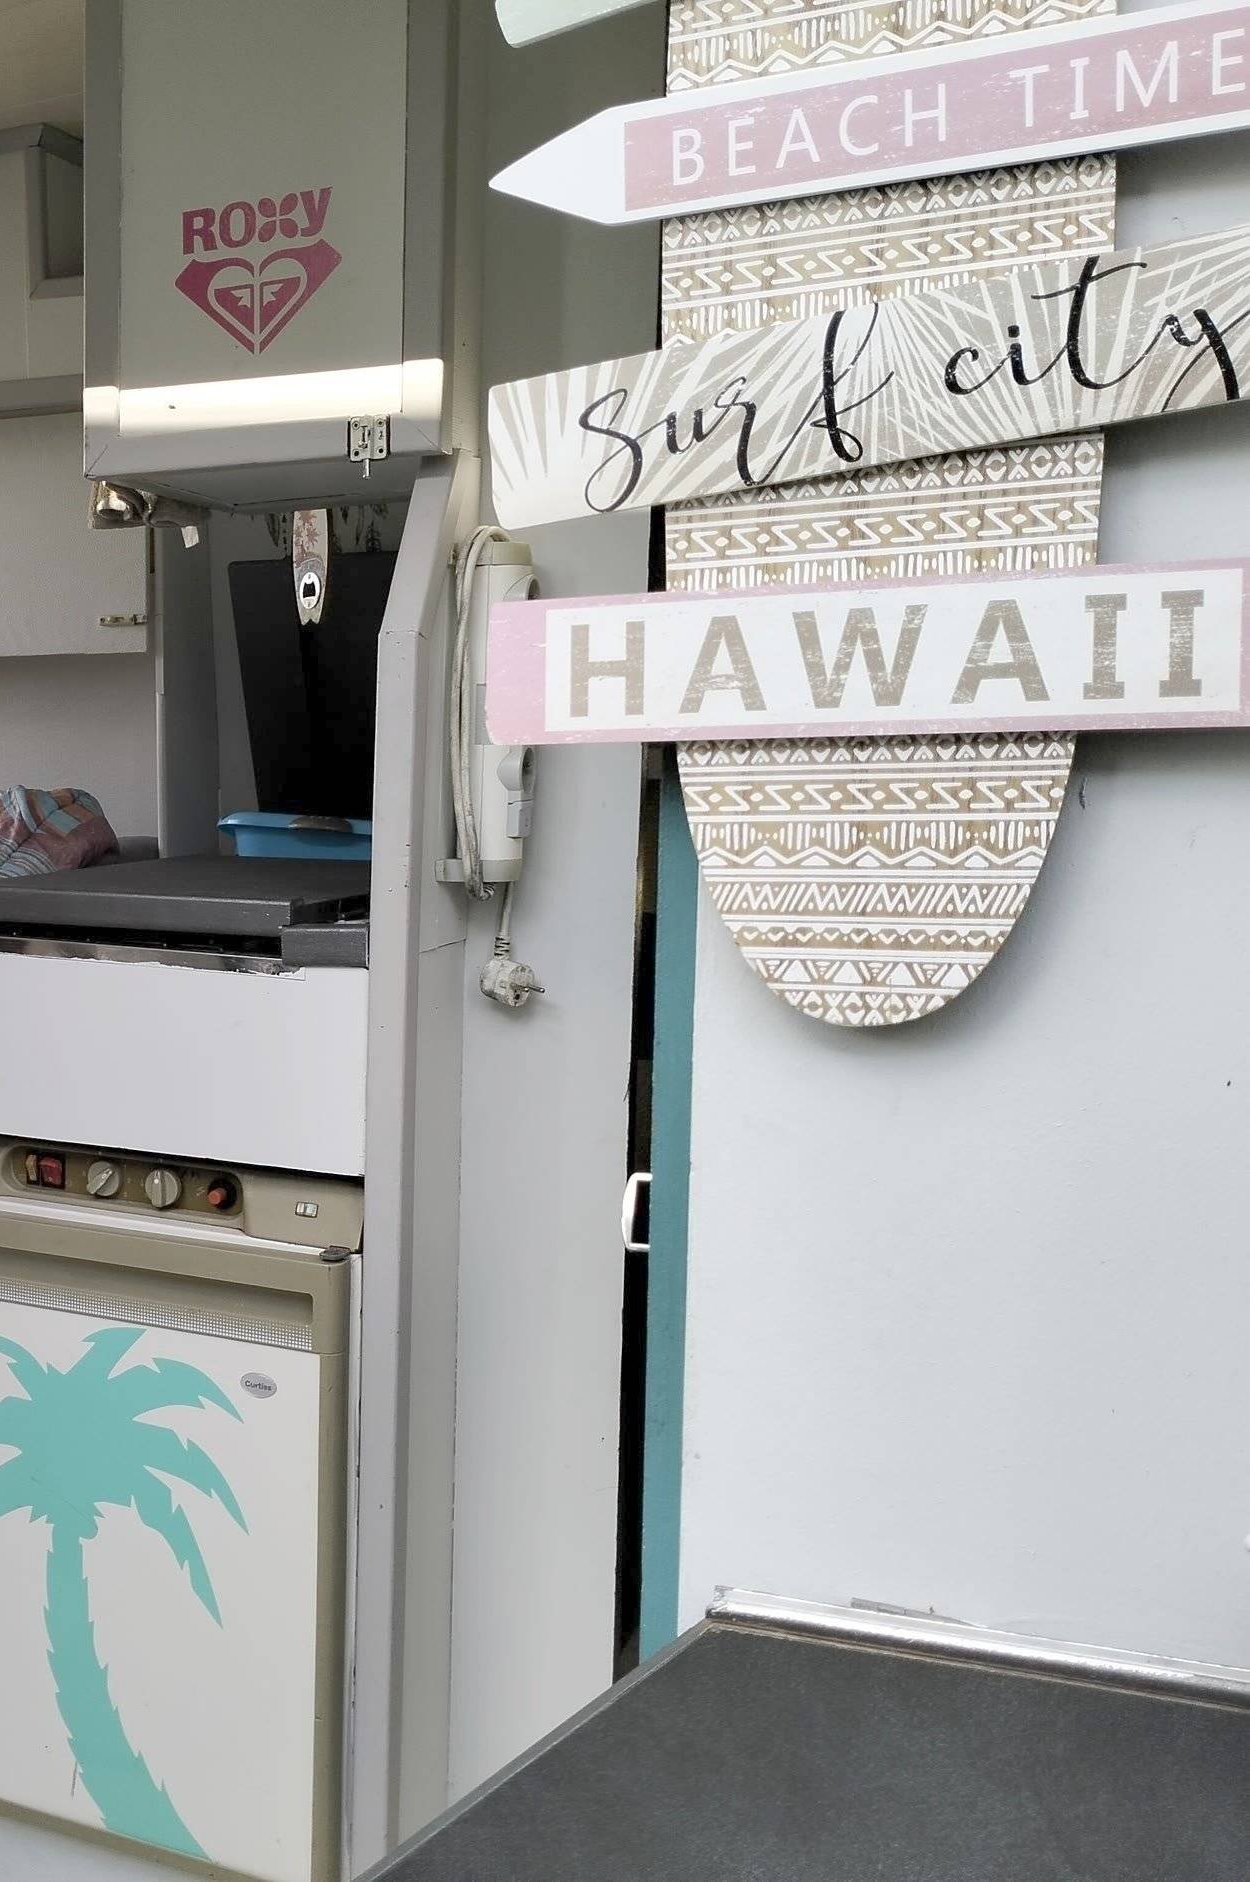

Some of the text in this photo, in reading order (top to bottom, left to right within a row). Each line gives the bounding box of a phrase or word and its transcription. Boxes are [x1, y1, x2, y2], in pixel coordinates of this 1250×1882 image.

[671, 27, 1247, 187] BEACH TIME
[181, 185, 334, 256] ROXY
[943, 254, 1250, 412] city
[568, 588, 1205, 718] HAWAII
